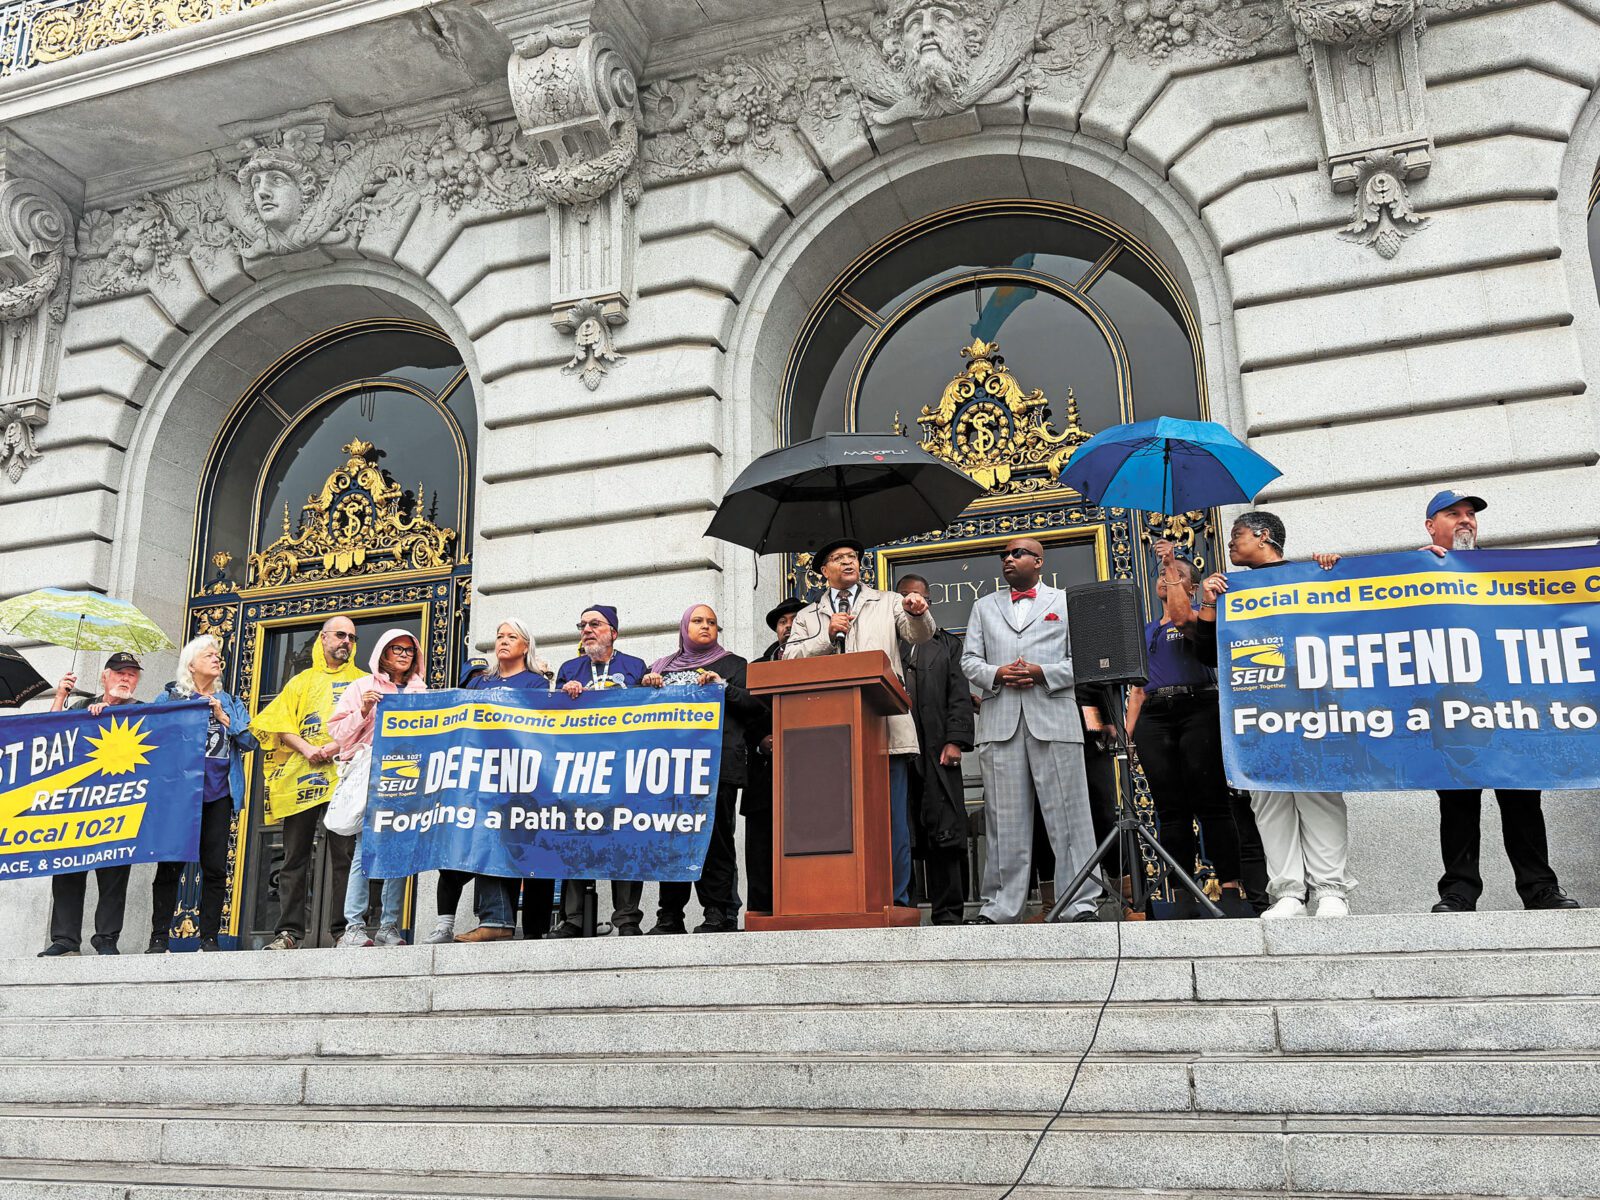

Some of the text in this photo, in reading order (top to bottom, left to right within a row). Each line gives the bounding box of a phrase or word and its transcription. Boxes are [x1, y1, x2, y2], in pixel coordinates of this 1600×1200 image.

[928, 580, 985, 605] CITY
[1231, 590, 1299, 613] Social
[1307, 586, 1351, 605] and
[1359, 579, 1478, 602] Economic
[1486, 578, 1577, 596] Justice
[1230, 636, 1284, 648] LOCAL 1021
[1295, 626, 1596, 690] DEFEND THE
[1230, 667, 1286, 686] SEIU
[386, 708, 714, 730] Social and Economic Justice Committee
[1233, 700, 1598, 739] Forging a Path to
[30, 727, 80, 777] BAY
[377, 778, 419, 792] SEIU
[424, 746, 712, 795] DEFEND THE VOTE
[30, 779, 150, 812] RETIREES
[0, 815, 127, 847] Local 1021
[373, 803, 707, 834] Forging a Path to Power
[38, 858, 49, 871] &
[52, 846, 137, 869] SOLIDARITY
